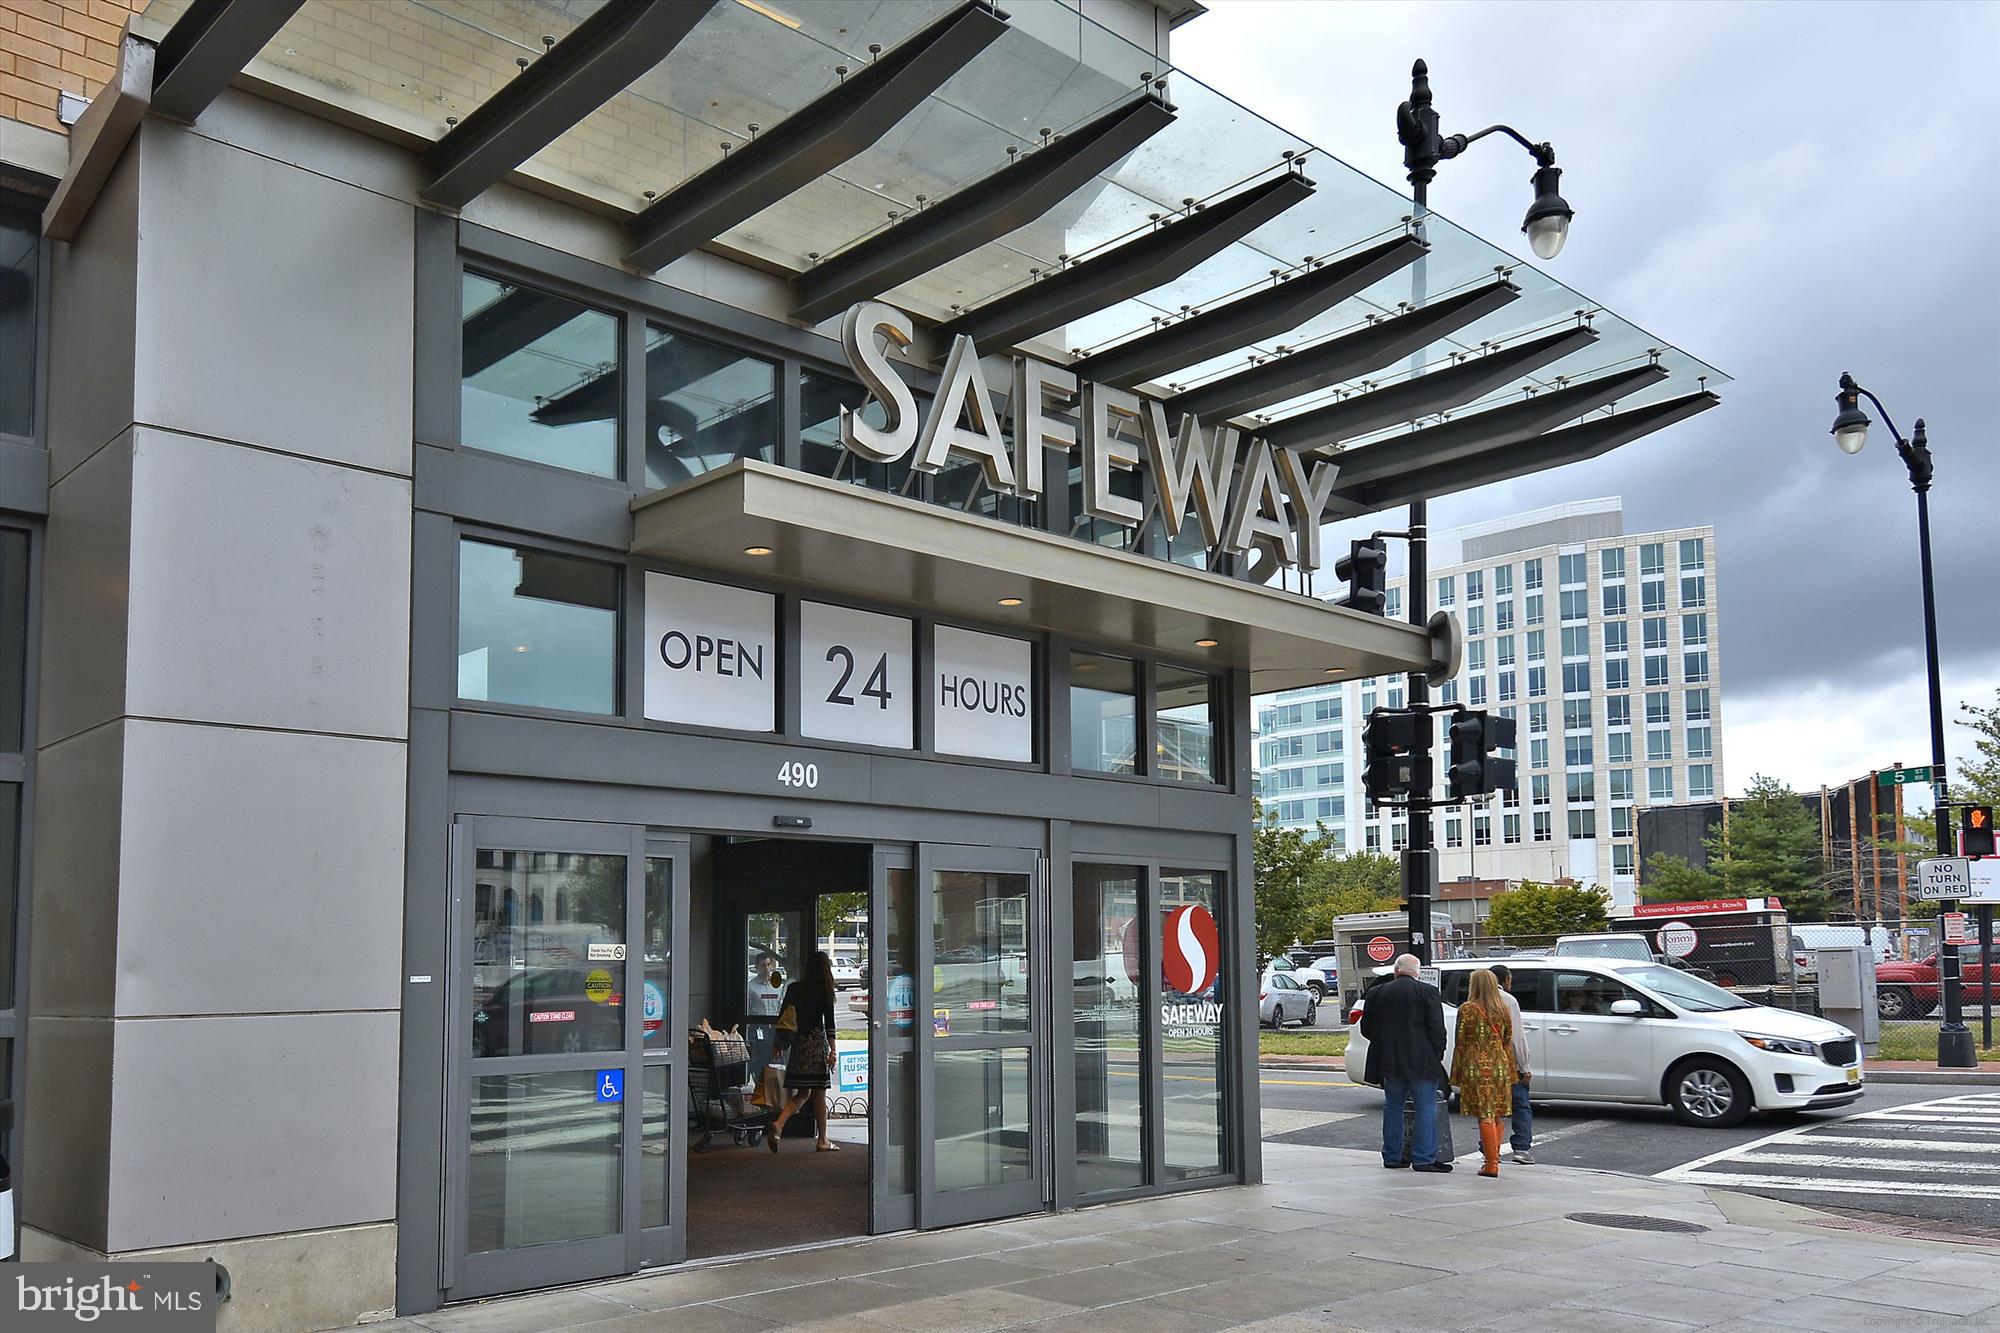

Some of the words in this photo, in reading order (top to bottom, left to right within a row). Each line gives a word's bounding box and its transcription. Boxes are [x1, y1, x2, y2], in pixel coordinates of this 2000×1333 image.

[840, 301, 1340, 573] SAFEWAY
[660, 630, 763, 681] OPEN
[825, 645, 892, 710] 24
[941, 673, 1026, 718] HOURS
[777, 761, 818, 788] 490
[1894, 770, 1905, 783] 5
[1934, 864, 1953, 873] NO
[1928, 874, 1961, 883] TURN
[1924, 886, 1939, 895] ON
[1945, 885, 1967, 894] RED
[1637, 906, 1675, 914] Vietnamese
[1676, 904, 1709, 913] Baguettes
[1722, 900, 1743, 908] Bowls
[1161, 1004, 1223, 1026] SAFEWAY
[1168, 1028, 1184, 1037] OPEN
[1186, 1028, 1193, 1036] 24
[1194, 1027, 1214, 1036] HOURS
